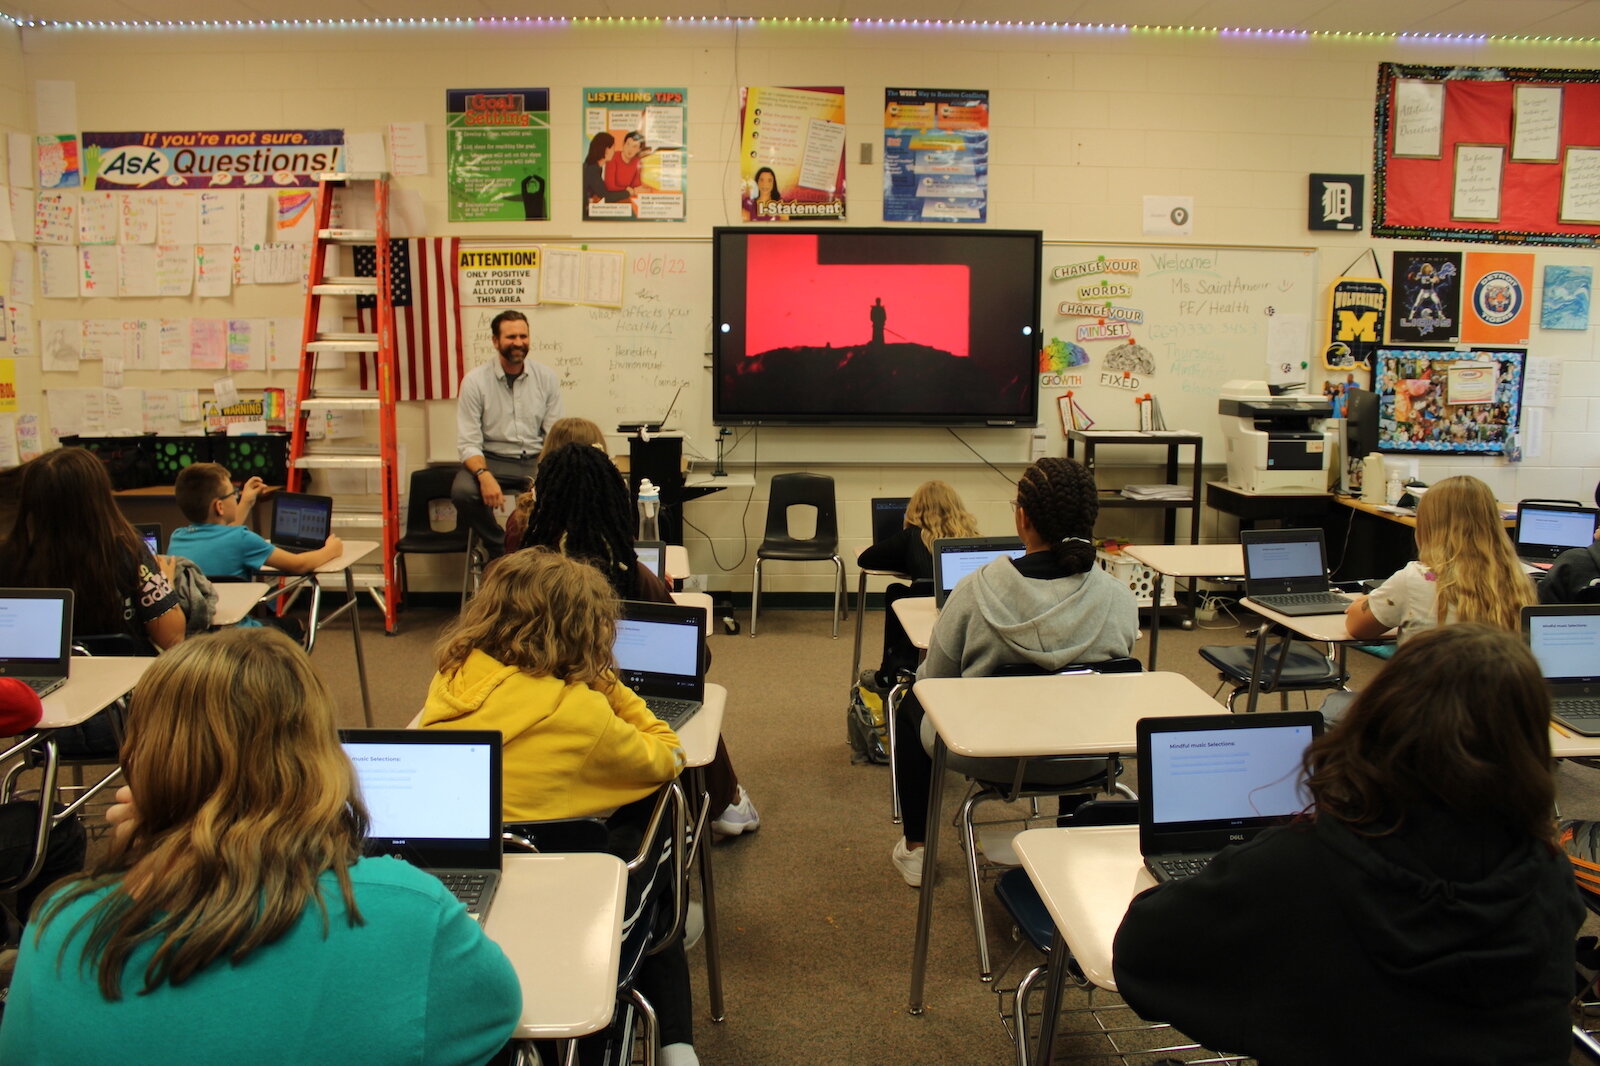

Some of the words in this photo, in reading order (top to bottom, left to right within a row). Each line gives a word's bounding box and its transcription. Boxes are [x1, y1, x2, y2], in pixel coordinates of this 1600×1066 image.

[471, 93, 515, 111] Goal
[587, 91, 652, 102] LISTENING
[655, 91, 683, 103] TIPS
[464, 109, 530, 128] Setting
[142, 132, 157, 146] If
[161, 132, 217, 149] you're
[224, 132, 255, 145] not
[103, 151, 161, 176] Ask
[173, 147, 339, 174] Questions!
[759, 201, 841, 215] I-Statement
[460, 251, 536, 267] ATTENTION!
[466, 271, 488, 279] ONLY
[491, 270, 531, 278] POSITIVE
[1054, 262, 1104, 278] CHANGE
[1104, 261, 1139, 271] YOUR
[475, 279, 522, 287] ATTITUDES
[1481, 273, 1518, 286] DETROIT
[473, 287, 514, 295] ALLOWED
[1060, 304, 1108, 316] CHANGE
[1108, 309, 1142, 321] YOUR
[1481, 311, 1515, 323] TIGERS
[1336, 310, 1378, 342] M
[1041, 375, 1082, 386] GROWTH
[1100, 373, 1140, 389] FIXED
[223, 403, 262, 415] WARNING
